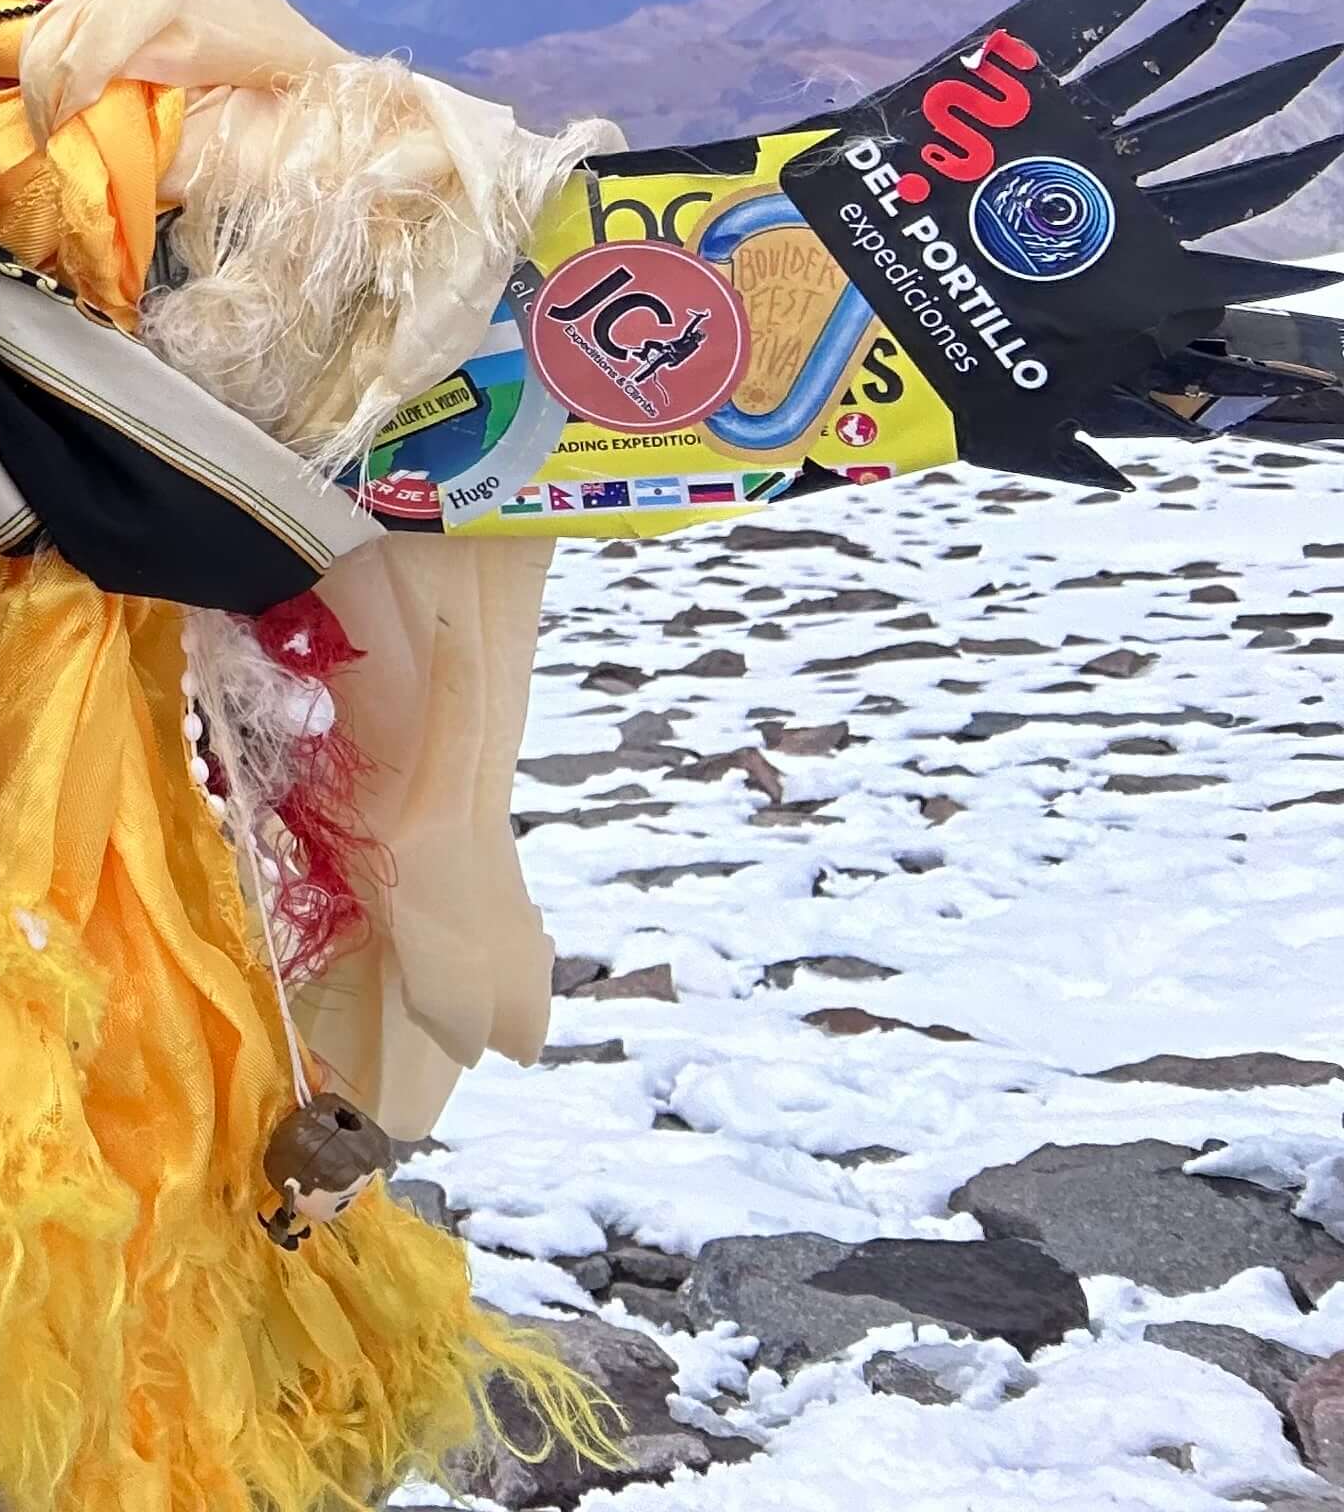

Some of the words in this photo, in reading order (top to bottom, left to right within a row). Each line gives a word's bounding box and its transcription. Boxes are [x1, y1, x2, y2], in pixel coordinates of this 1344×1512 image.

[844, 137, 903, 218] DEL
[901, 215, 1049, 390] PORTILLO
[838, 202, 979, 373] expediciones
[546, 264, 675, 363] JC
[564, 324, 618, 379] Expeditions
[395, 404, 427, 426] LLEVE
[422, 400, 440, 417] EL
[434, 386, 470, 410] VIENTO
[551, 439, 609, 454] ADING
[395, 490, 423, 502] DE
[447, 475, 500, 509] Hugo
